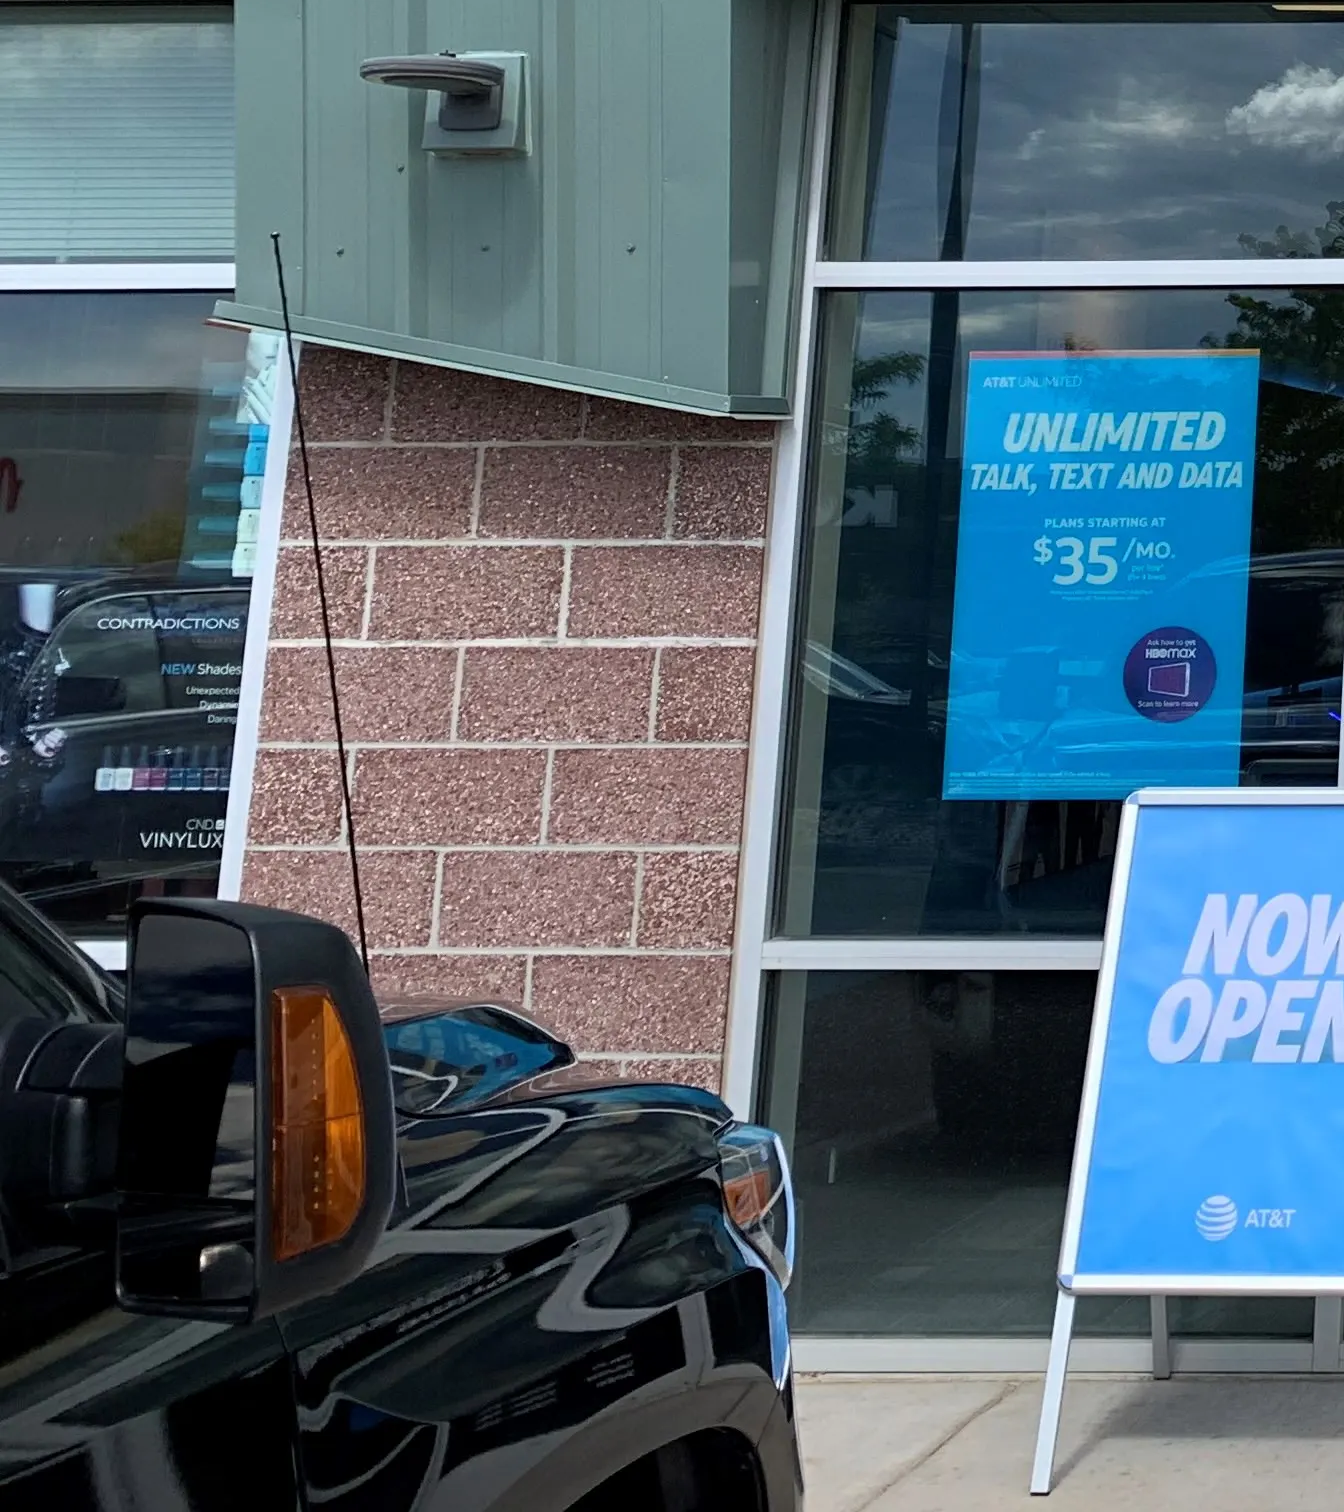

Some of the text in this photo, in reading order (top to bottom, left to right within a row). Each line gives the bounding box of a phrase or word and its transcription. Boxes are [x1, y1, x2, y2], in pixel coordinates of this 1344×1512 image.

[1003, 411, 1226, 454] UNLIMITED
[970, 461, 1243, 496] TALK, TEXT AND DATA
[1044, 516, 1167, 529] PLANS STARTING AT
[97, 617, 240, 630] CONTRADICTIONS
[161, 663, 242, 676] NEW Shades
[186, 685, 241, 698] Unexpected
[139, 832, 224, 849] VINYLUX
[1244, 1208, 1296, 1229] AT&T
